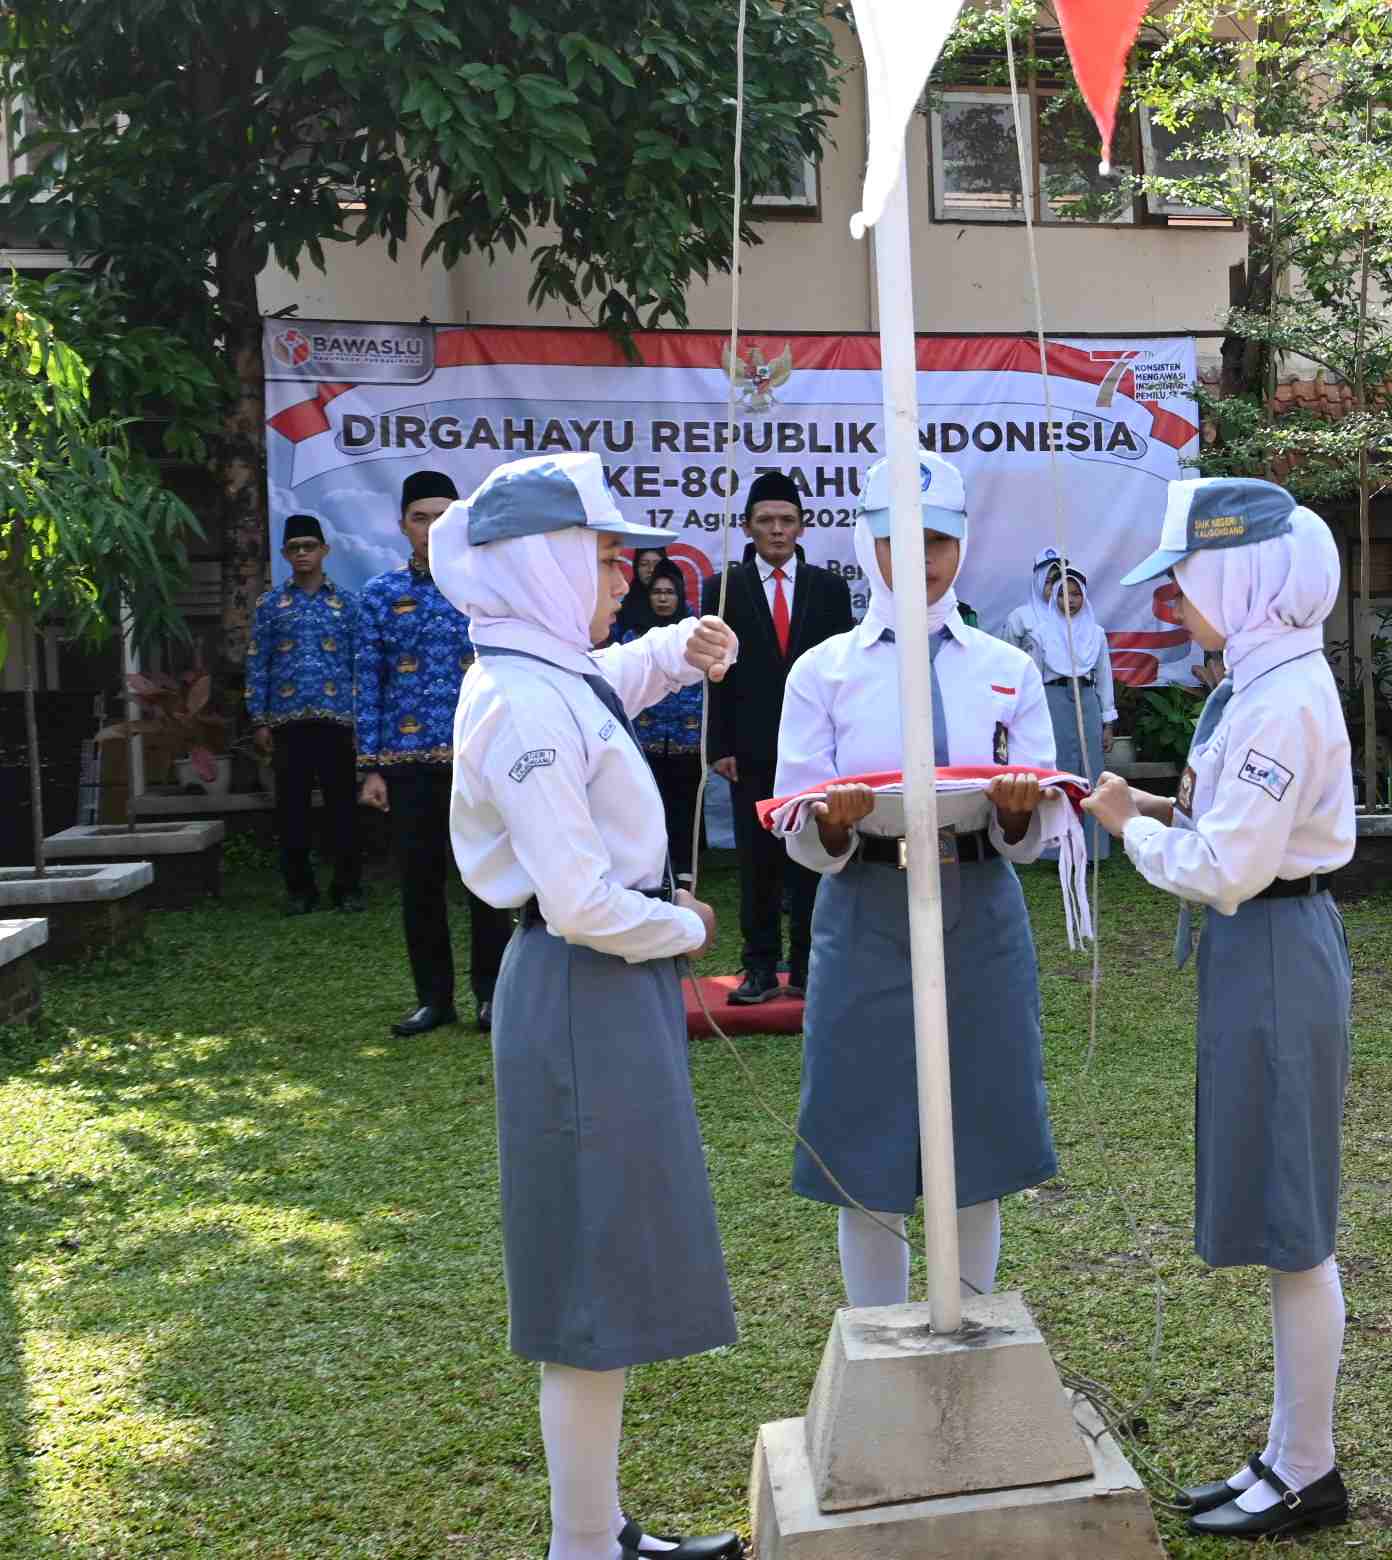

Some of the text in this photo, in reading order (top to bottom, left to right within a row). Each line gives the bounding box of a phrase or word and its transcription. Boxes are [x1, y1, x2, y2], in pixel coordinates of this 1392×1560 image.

[313, 337, 421, 354] BAWASLU
[1134, 363, 1181, 372] KONSISTEN
[1135, 373, 1186, 381] MENGAWASI
[1135, 391, 1166, 400] PEMILU
[342, 414, 1138, 453] DIRGAHAYU REPUBLIK NDONESIA
[602, 465, 740, 498] KE-80
[646, 508, 674, 529] 17
[801, 508, 857, 528] 202
